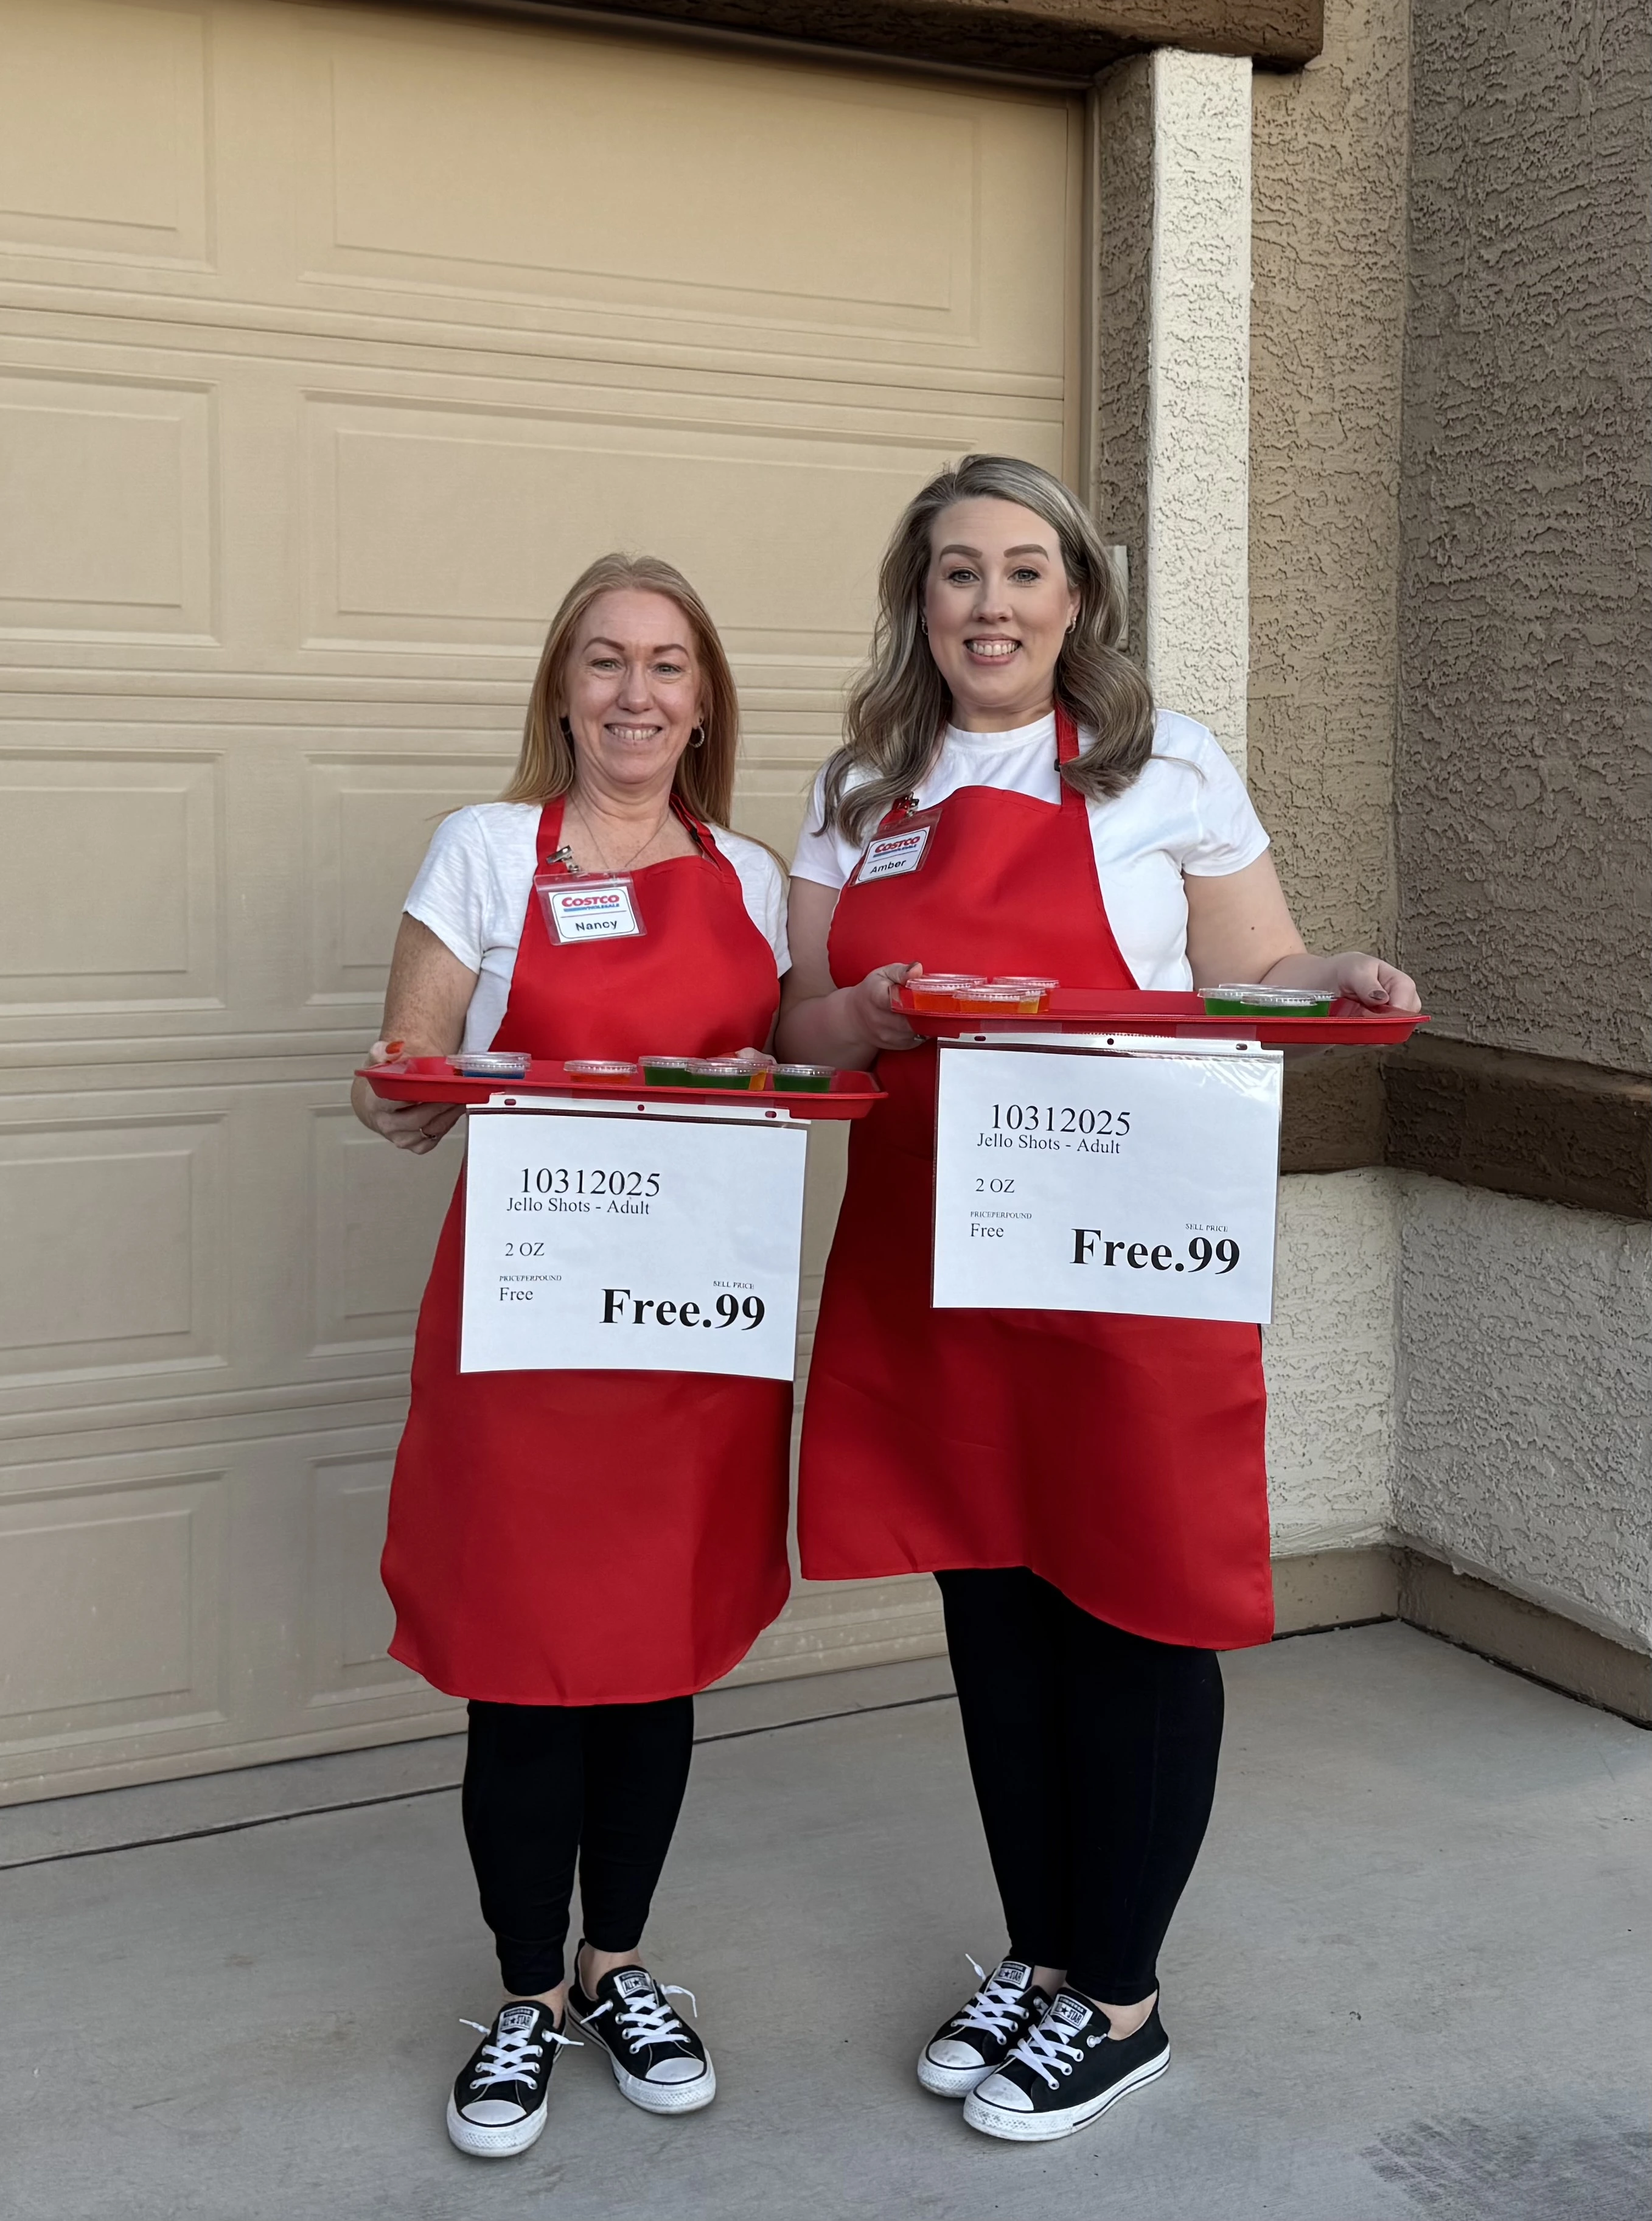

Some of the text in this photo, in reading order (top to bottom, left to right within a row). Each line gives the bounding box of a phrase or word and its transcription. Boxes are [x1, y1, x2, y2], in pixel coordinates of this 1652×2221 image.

[875, 836, 921, 853] COSTCO
[870, 860, 907, 874] Amber
[562, 894, 619, 907] COSTCO
[576, 920, 617, 932] Nancy
[991, 1104, 1131, 1136] 10312025
[977, 1132, 1013, 1149] Jello
[1018, 1134, 1061, 1151] Shots
[1076, 1138, 1121, 1154] Adult
[521, 1168, 660, 1197] 10312025
[975, 1178, 1015, 1193] 2 OZ
[506, 1197, 543, 1212] Jello
[548, 1198, 590, 1213] Shots
[606, 1199, 650, 1215] Adult
[970, 1222, 1004, 1238] Free
[504, 1242, 545, 1257] 2 OZ
[1069, 1228, 1241, 1275] Free.99
[500, 1287, 534, 1302] Free
[599, 1289, 766, 1331] Free.99
